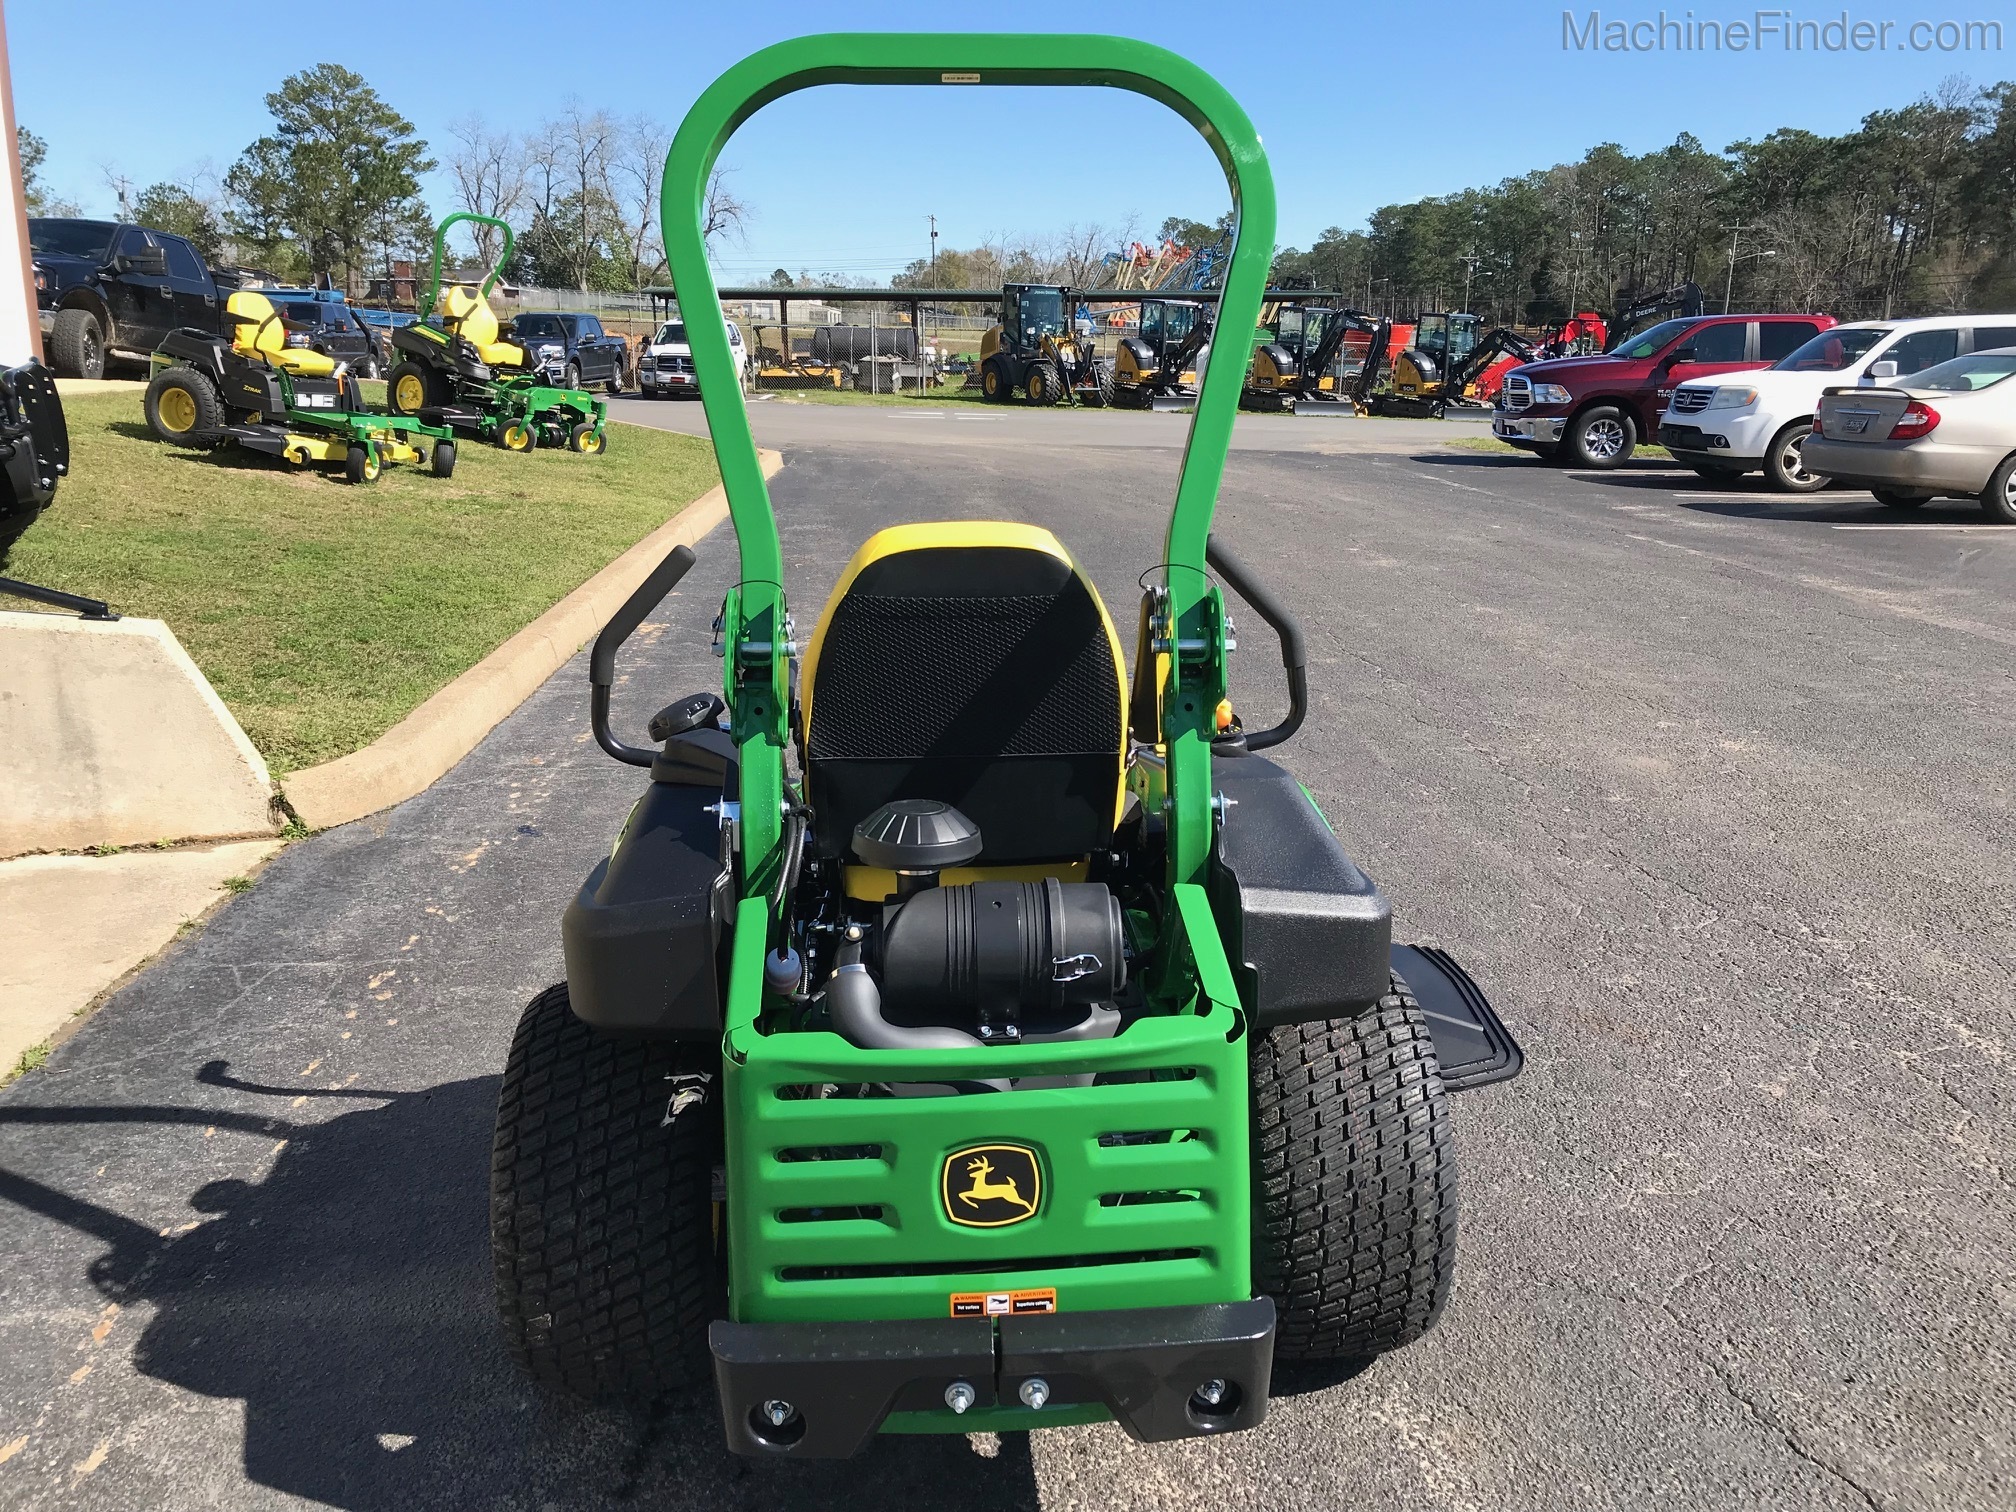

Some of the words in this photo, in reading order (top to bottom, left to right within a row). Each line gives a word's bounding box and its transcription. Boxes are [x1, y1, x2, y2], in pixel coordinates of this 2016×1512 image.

[1635, 306, 1657, 317] DEERE
[1345, 320, 1360, 329] DEERE
[1503, 342, 1519, 356] DEERE
